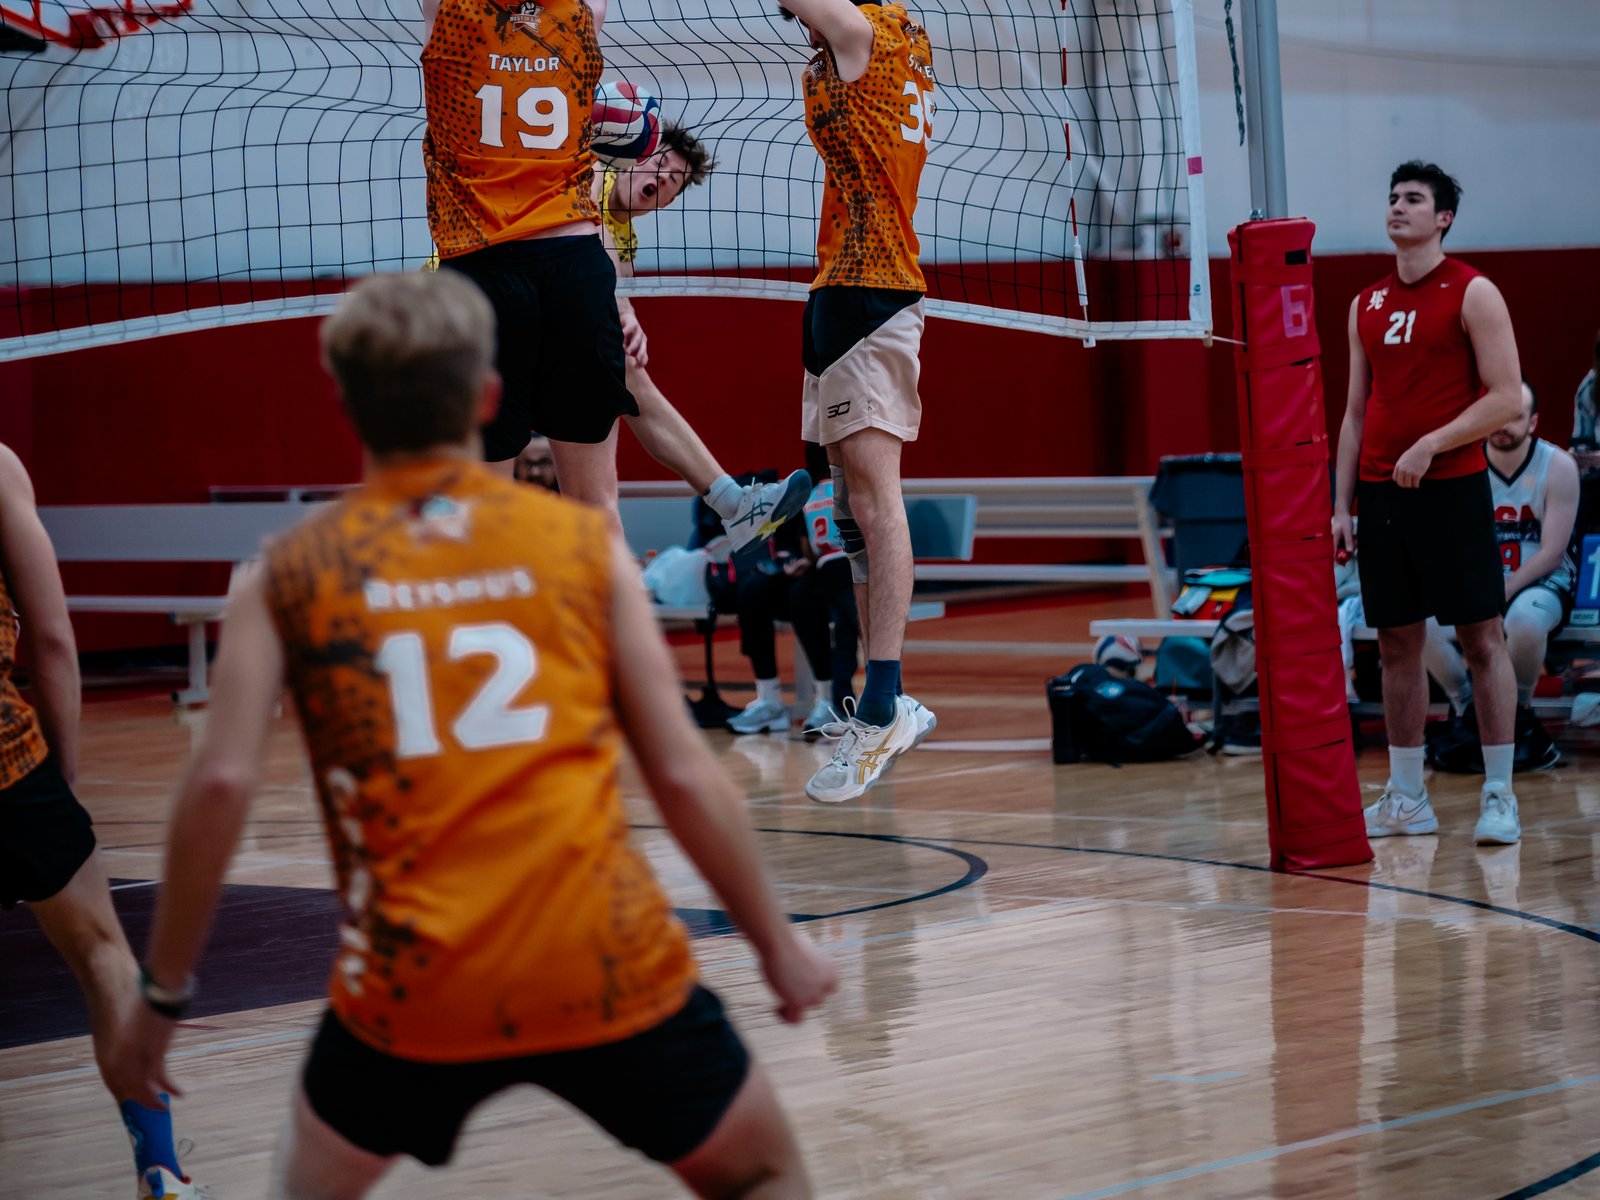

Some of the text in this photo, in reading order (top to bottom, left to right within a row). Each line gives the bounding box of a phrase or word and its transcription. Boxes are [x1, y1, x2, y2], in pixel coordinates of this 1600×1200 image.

[488, 53, 560, 72] TAYLOR
[474, 84, 569, 150] 19
[1384, 310, 1417, 345] 21
[375, 620, 549, 758] 12
